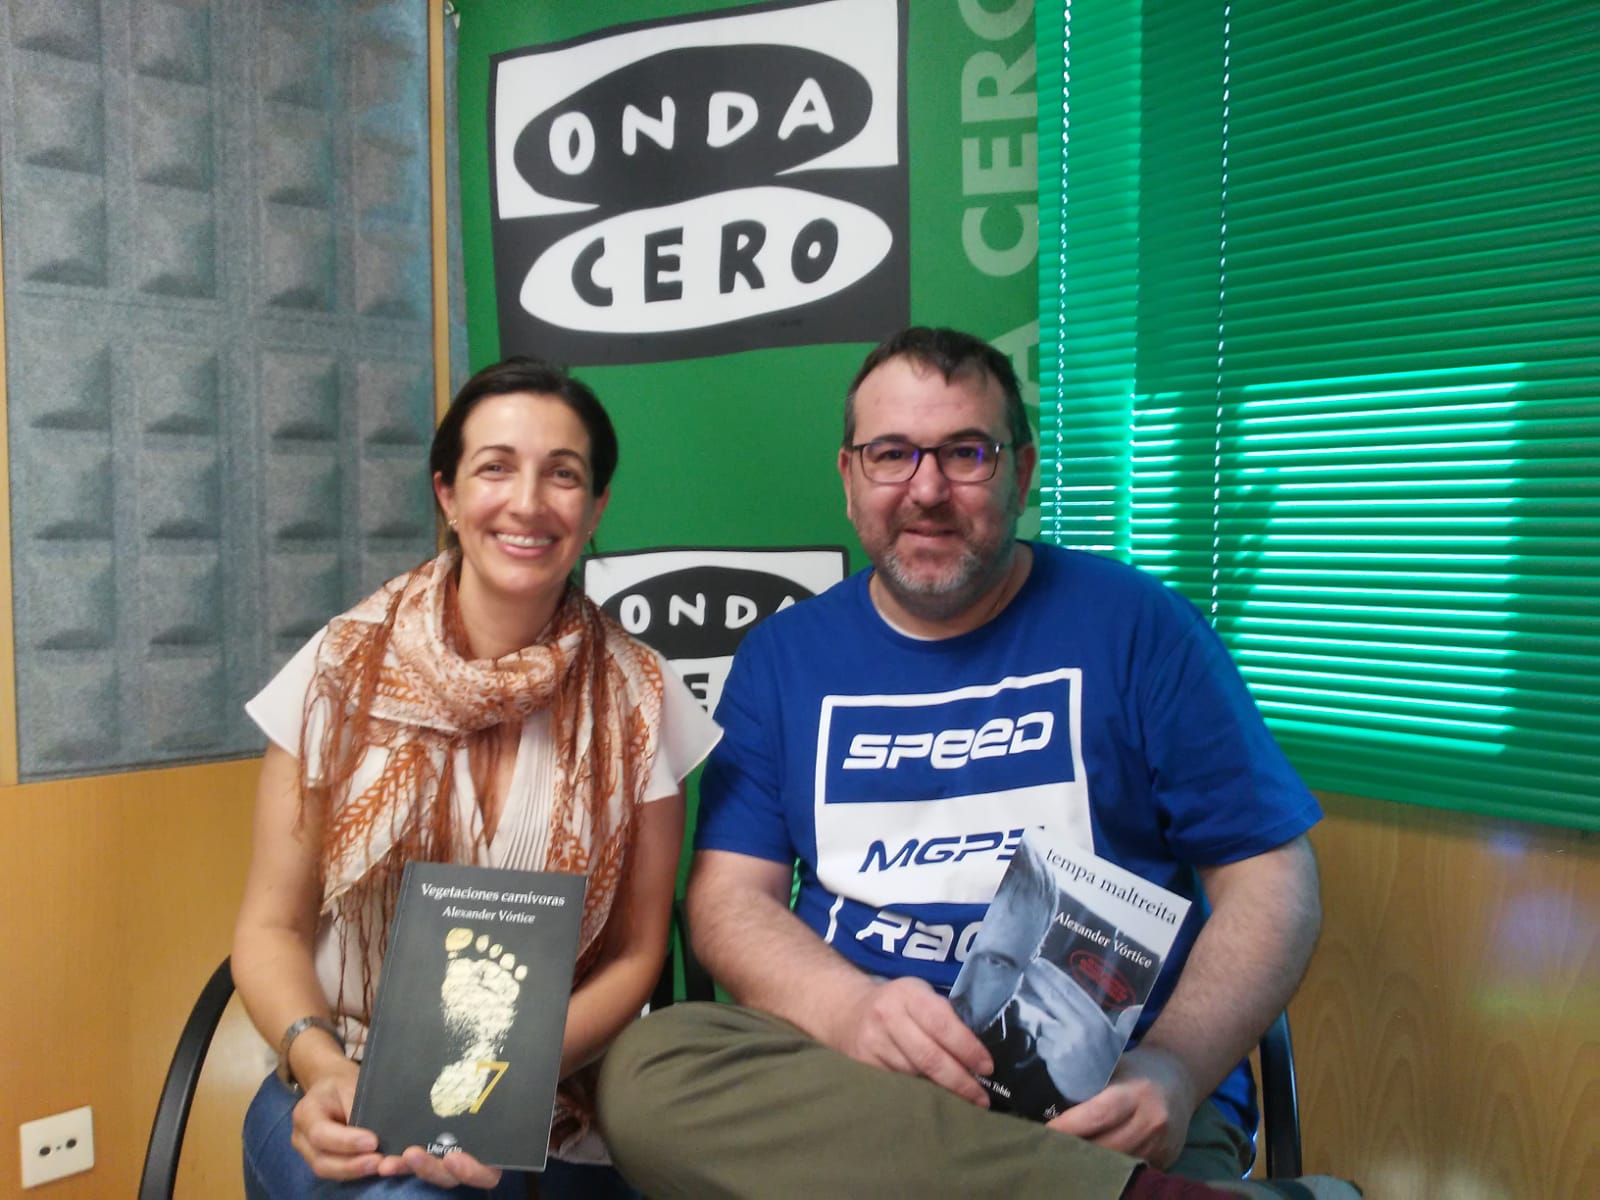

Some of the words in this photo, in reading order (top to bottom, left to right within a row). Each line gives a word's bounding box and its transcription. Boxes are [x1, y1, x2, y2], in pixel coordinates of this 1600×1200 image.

[549, 78, 834, 175] ONDA
[571, 217, 838, 308] CERO
[620, 592, 796, 634] OND
[421, 883, 499, 901] Vegetaciones
[501, 891, 566, 907] carnívoras
[442, 906, 496, 921] Alexander
[499, 910, 536, 924] Vórtice
[1100, 878, 1178, 925] maltreita
[1055, 911, 1111, 947] Alexander
[1113, 938, 1153, 969] Vórtice
